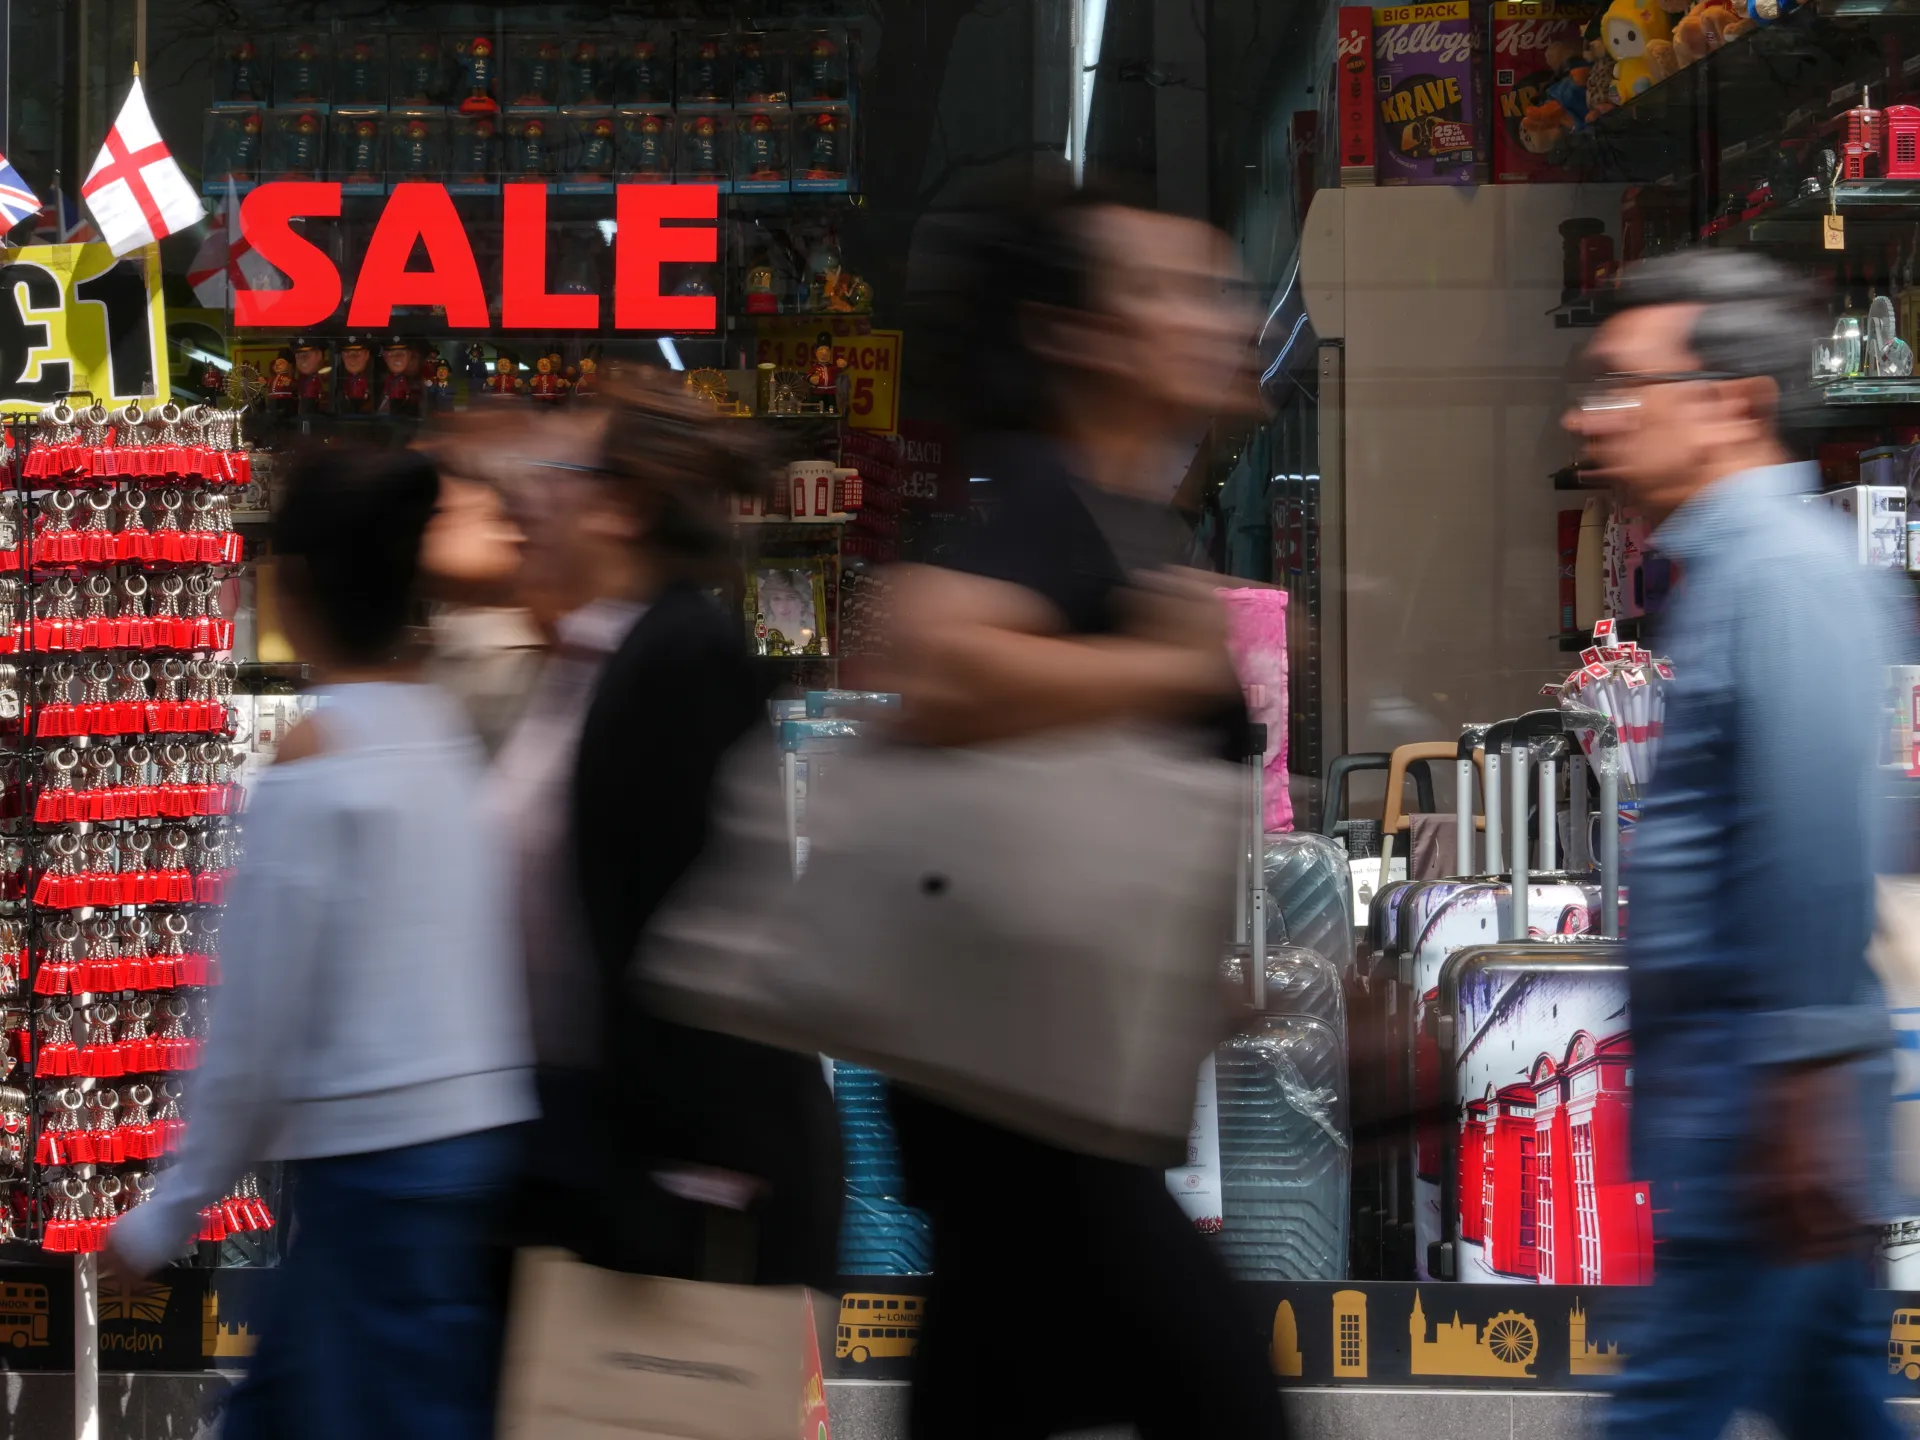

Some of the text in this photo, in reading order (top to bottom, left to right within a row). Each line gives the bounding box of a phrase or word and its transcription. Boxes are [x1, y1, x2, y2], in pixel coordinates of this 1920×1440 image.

[1383, 4, 1459, 22] BIG PACK
[1507, 5, 1535, 16] BIG
[1381, 77, 1462, 123] KRAVE
[1440, 135, 1466, 144] great
[233, 182, 718, 331] SALE
[0, 259, 159, 406] £1
[833, 346, 890, 371] EACH
[907, 440, 942, 465] EACH
[909, 471, 938, 499] £5
[0, 1299, 29, 1309] NDON
[887, 1313, 922, 1323] LONDO
[100, 1327, 163, 1353] ondon
